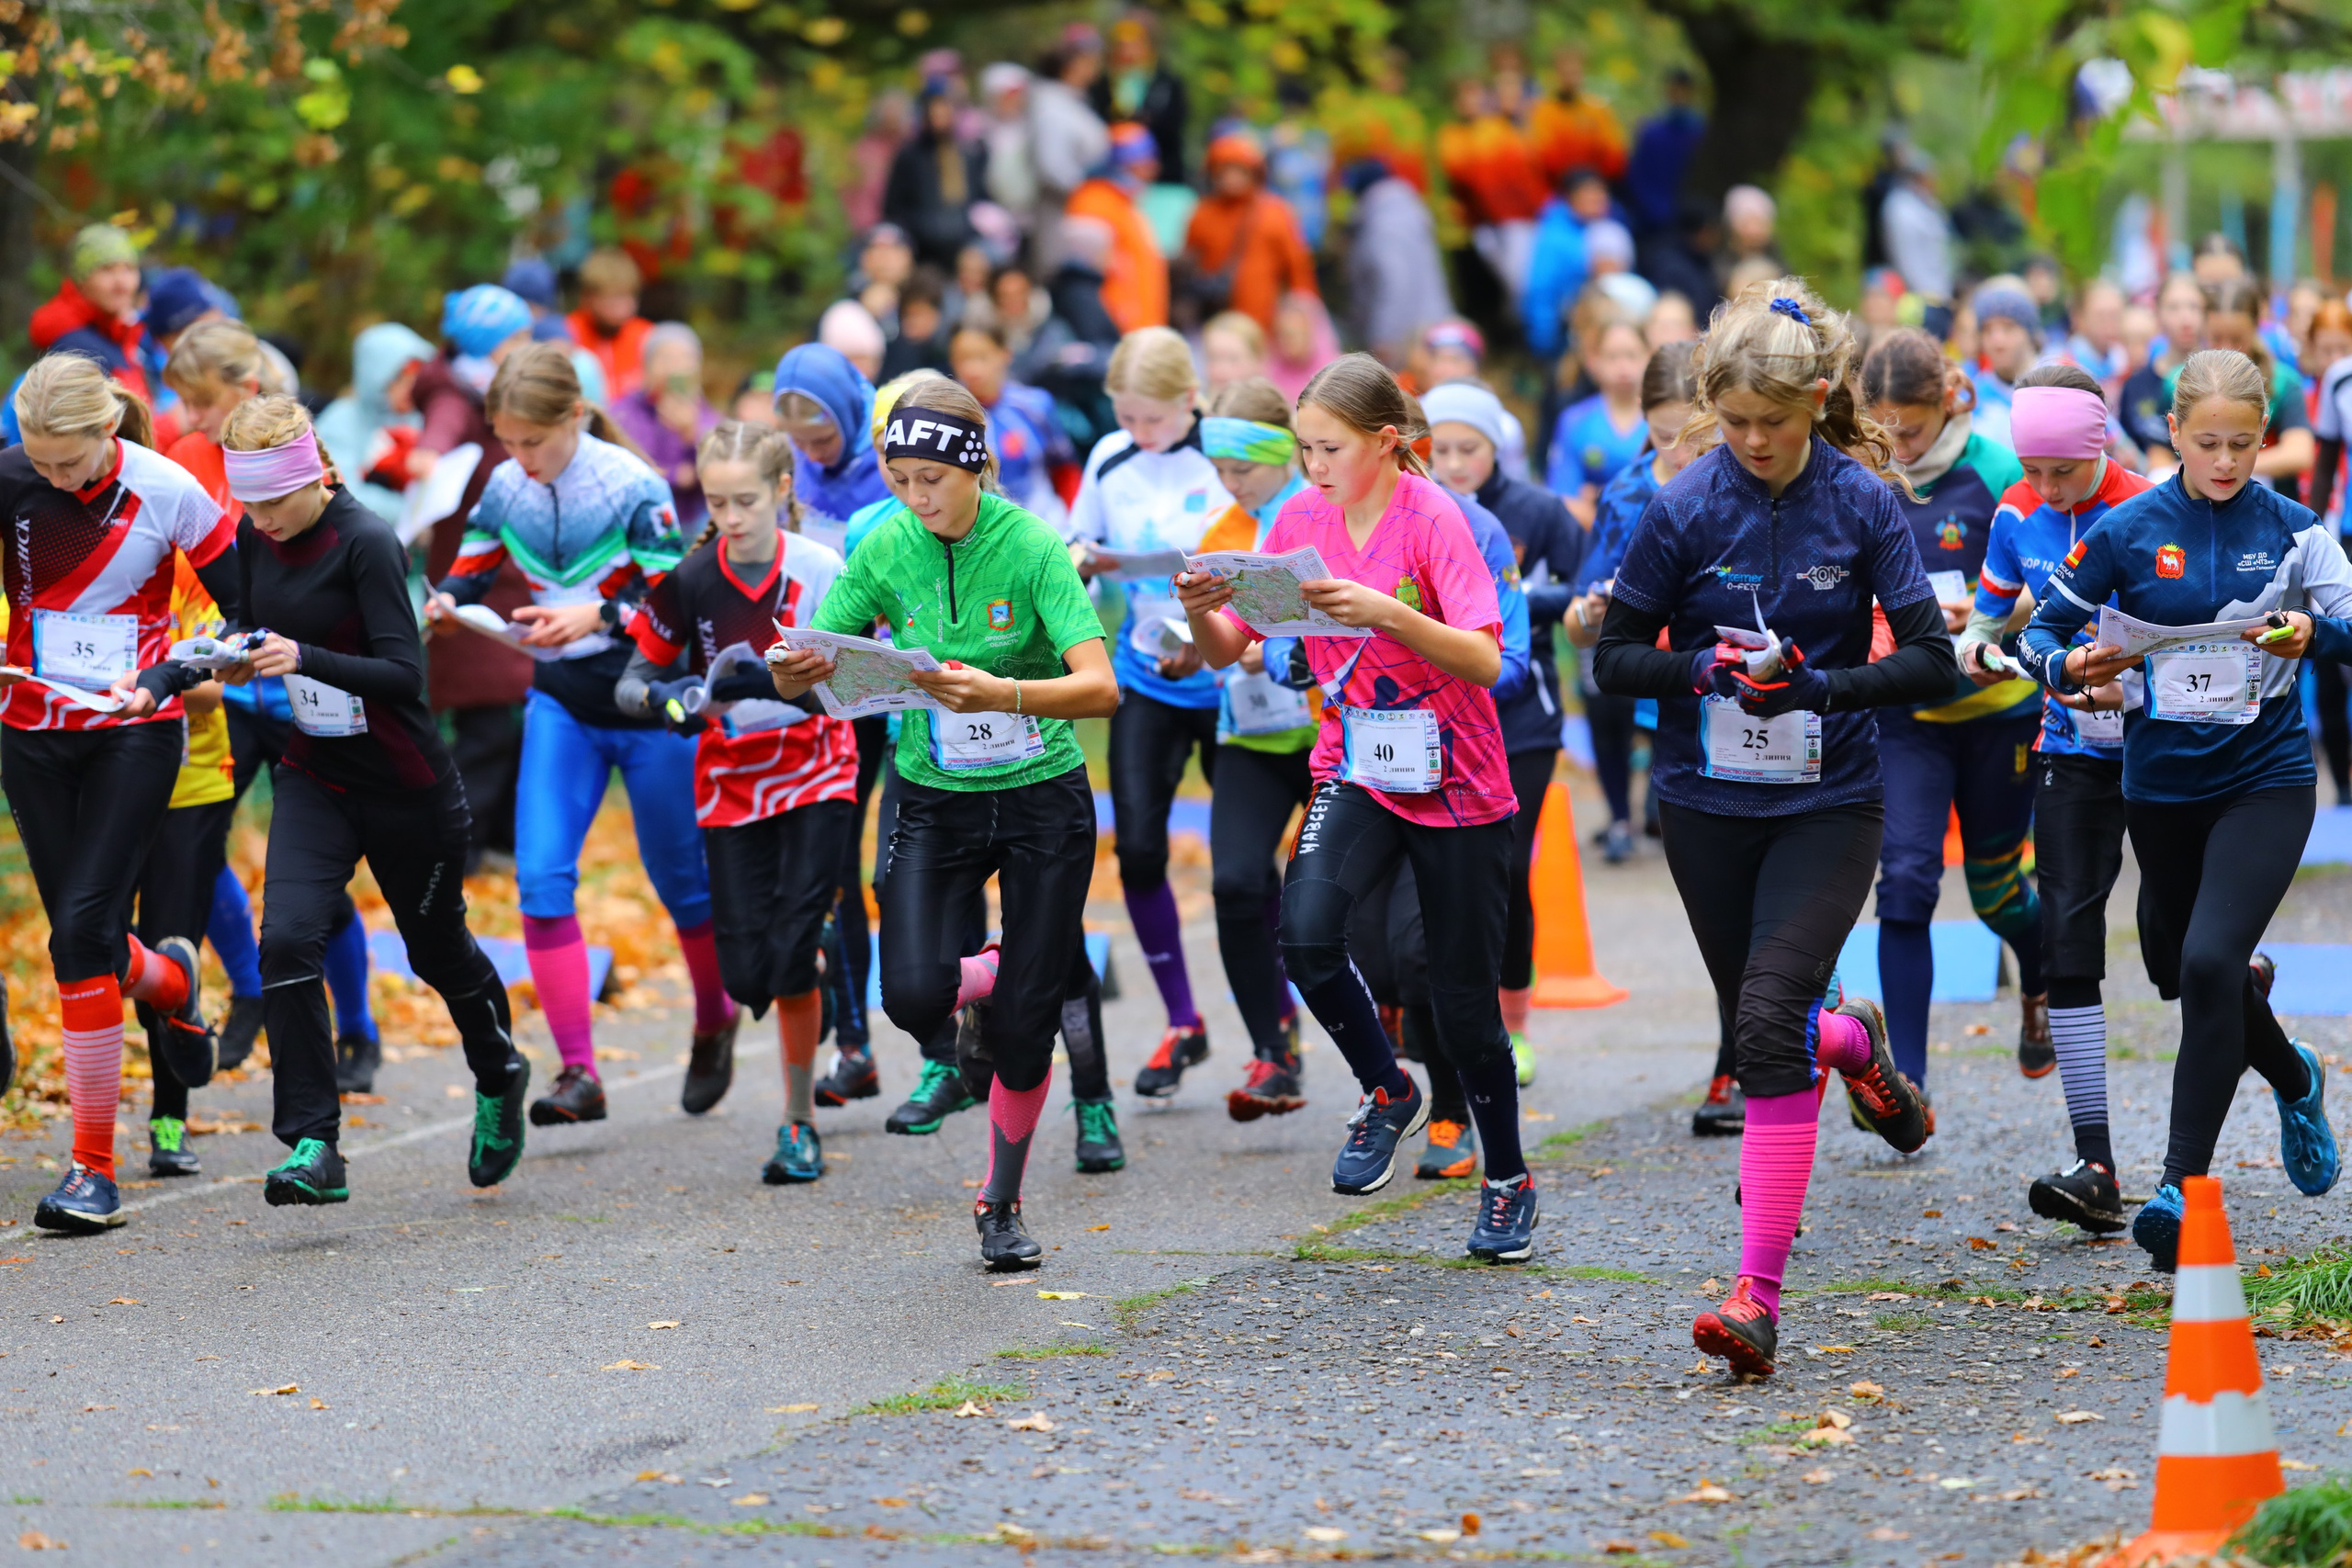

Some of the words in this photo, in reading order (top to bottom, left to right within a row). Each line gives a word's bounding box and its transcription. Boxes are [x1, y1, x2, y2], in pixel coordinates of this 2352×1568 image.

[884, 419, 964, 452] AFT
[2041, 559, 2055, 572] 18
[984, 630, 1022, 642] ОРЛОВСКАЯ
[989, 638, 1019, 649] ОБЛАСТЬ
[71, 640, 96, 660] 35
[2186, 673, 2211, 693] 37
[300, 689, 319, 707] 34
[967, 723, 993, 740] 28
[1742, 728, 1769, 750] 25
[1374, 743, 1394, 762] 40
[983, 756, 1021, 767] СОРЕВНОВАНИЯ
[1712, 772, 1751, 782] ВСЕРОССИЙСКИЕ
